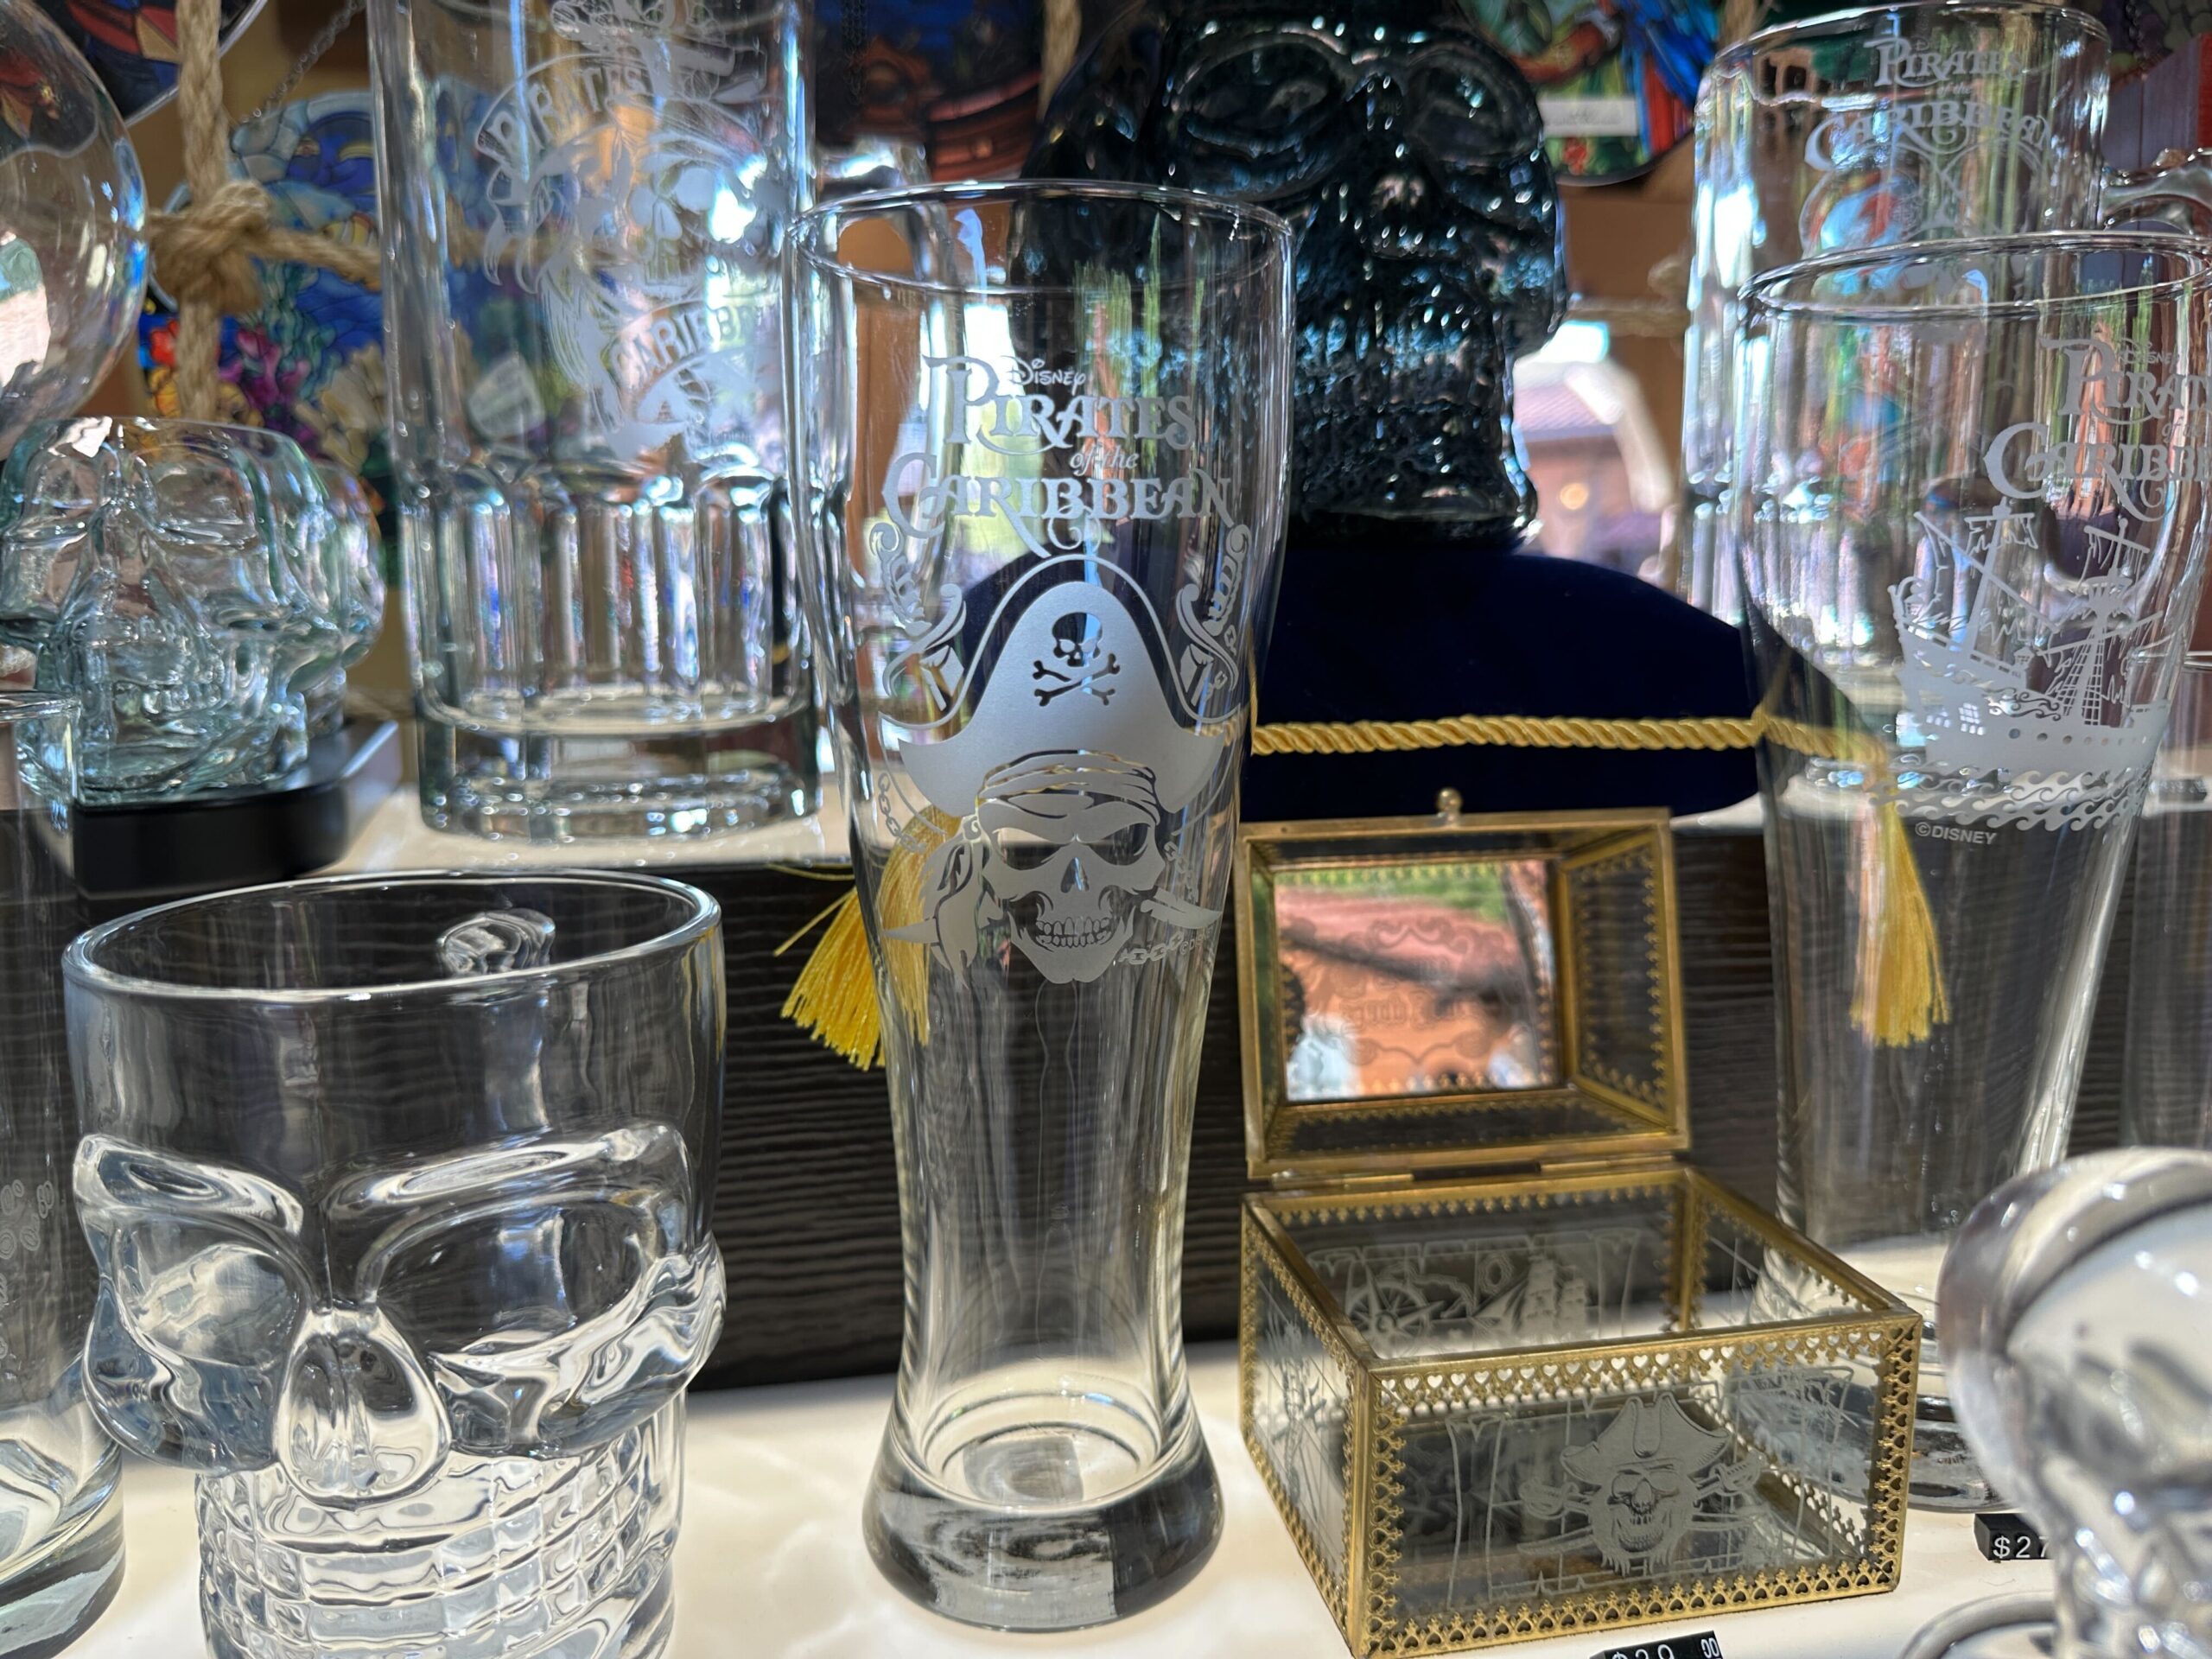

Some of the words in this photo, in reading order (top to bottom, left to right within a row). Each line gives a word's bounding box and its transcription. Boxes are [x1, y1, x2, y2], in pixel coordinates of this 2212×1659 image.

[920, 355, 1197, 456] PIRATES
[881, 452, 1236, 558] CARIBBEAN
[1070, 443, 1096, 477] of
[1100, 443, 1140, 469] the
